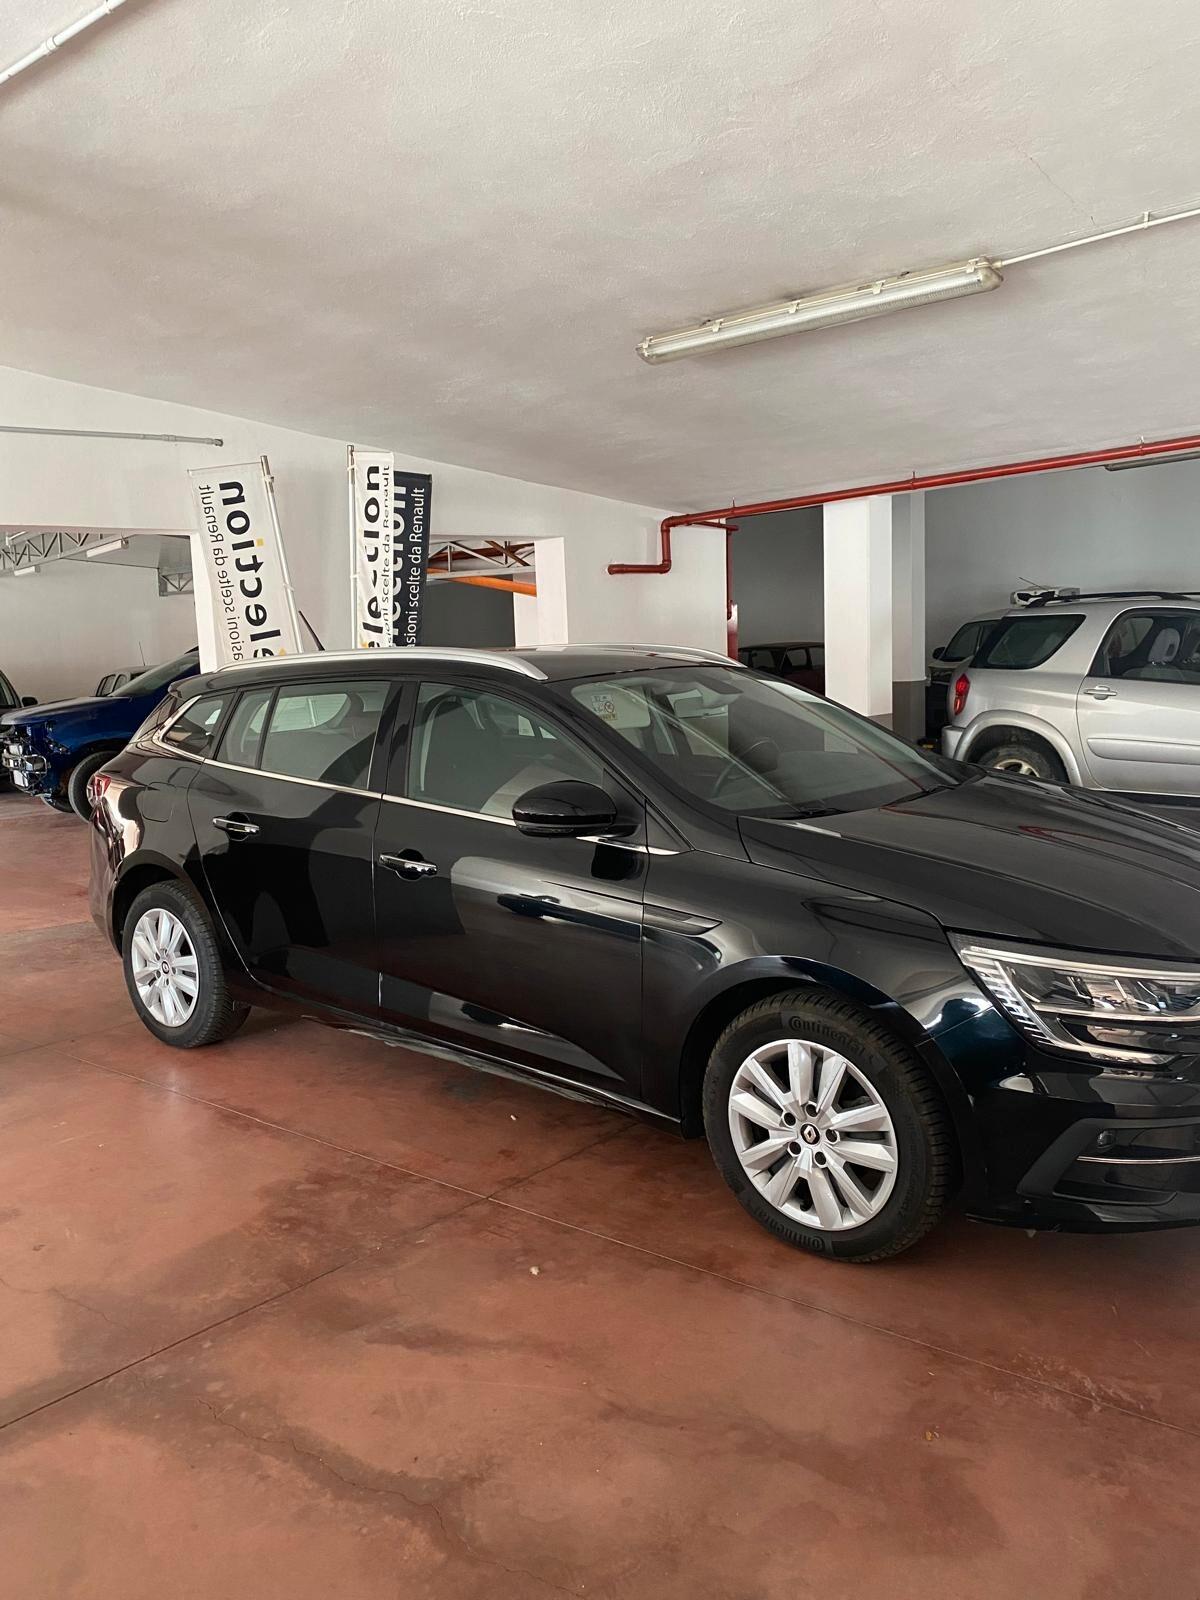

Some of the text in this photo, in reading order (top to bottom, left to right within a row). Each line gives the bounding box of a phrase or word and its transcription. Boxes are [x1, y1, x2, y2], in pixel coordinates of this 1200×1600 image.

[381, 465, 390, 528] Renault
[409, 487, 425, 542] Renault
[381, 534, 391, 553] da
[408, 546, 422, 564] da
[381, 558, 391, 603] scelte
[406, 567, 421, 607] scelte
[788, 1016, 865, 1057] Continental
